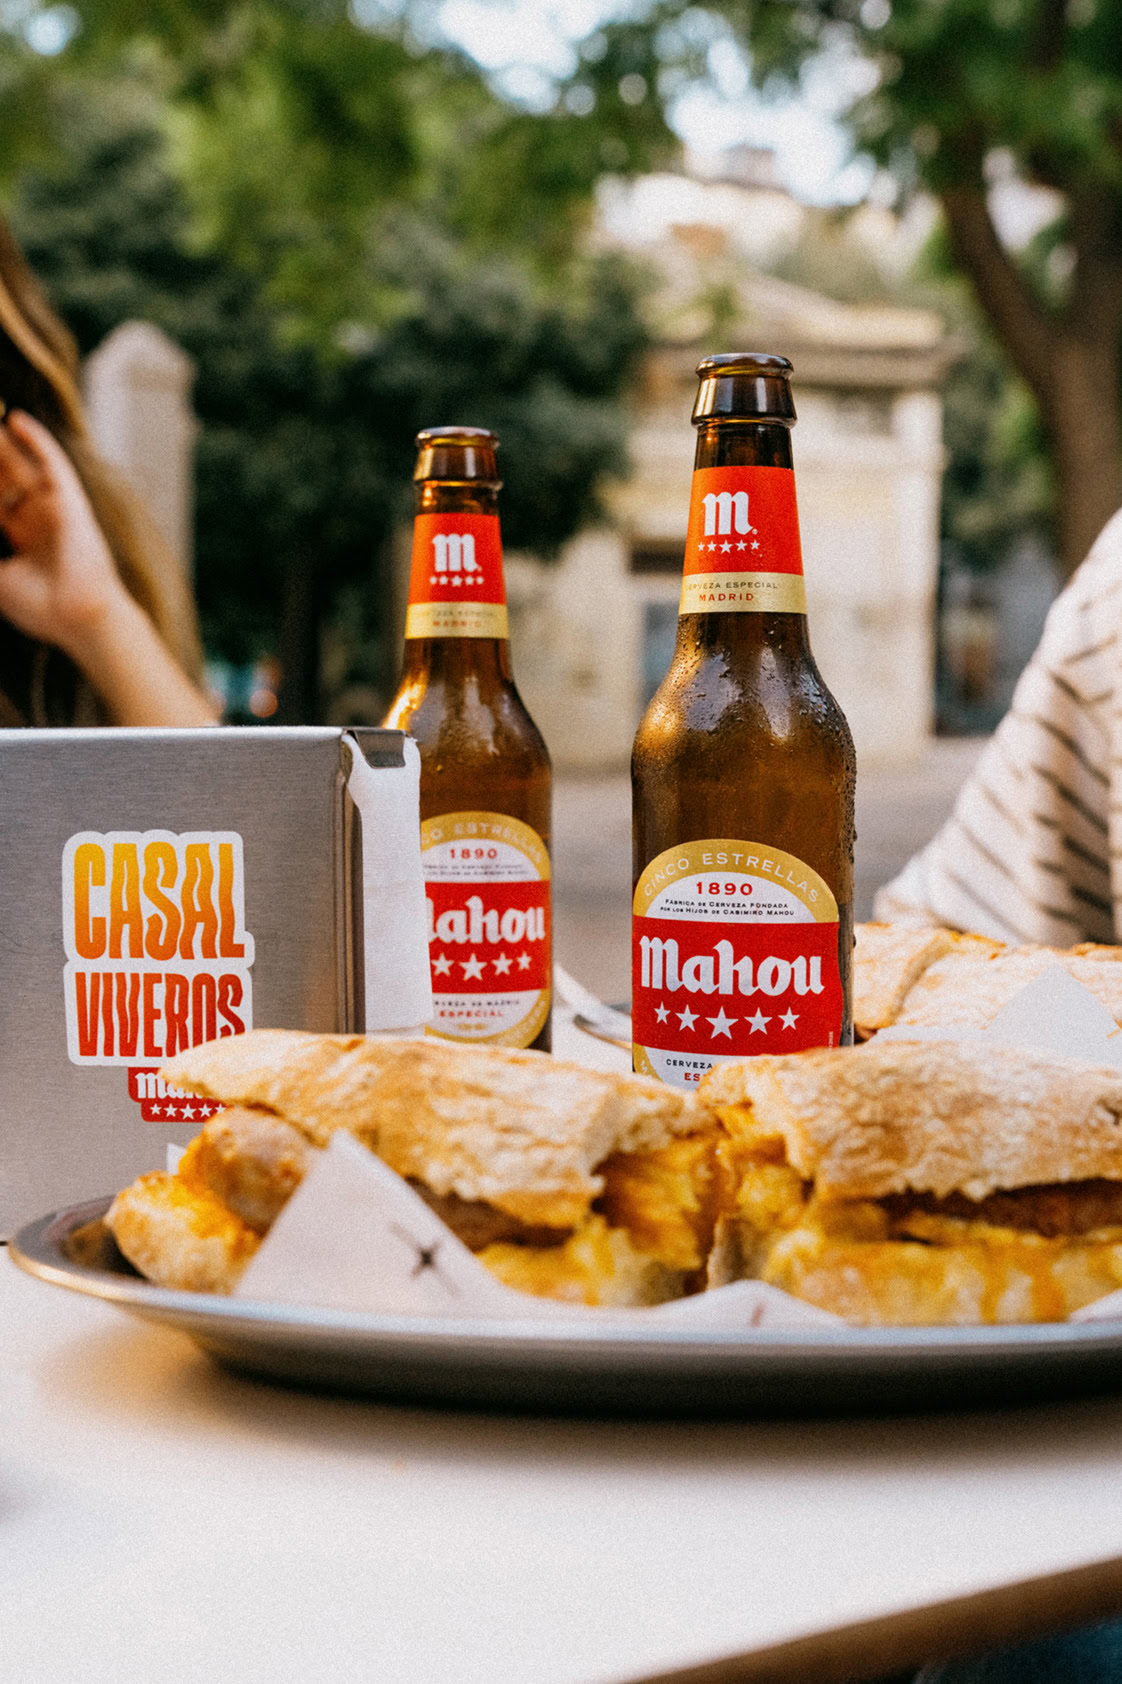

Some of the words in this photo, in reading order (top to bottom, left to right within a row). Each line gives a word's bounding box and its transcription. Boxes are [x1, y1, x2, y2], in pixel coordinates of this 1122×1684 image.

[685, 582, 721, 592] ERVEZA
[726, 581, 778, 589] ESPECIAL
[699, 593, 754, 602] MADRID
[449, 848, 498, 860] 1890
[643, 857, 690, 897] CINCO
[702, 852, 820, 903] ESTRELLAS
[697, 881, 753, 896] 1890
[73, 841, 246, 961] CASAL
[425, 895, 546, 944] ahou
[74, 971, 246, 1058] VIVEROS
[665, 1058, 713, 1069] CERVEZA
